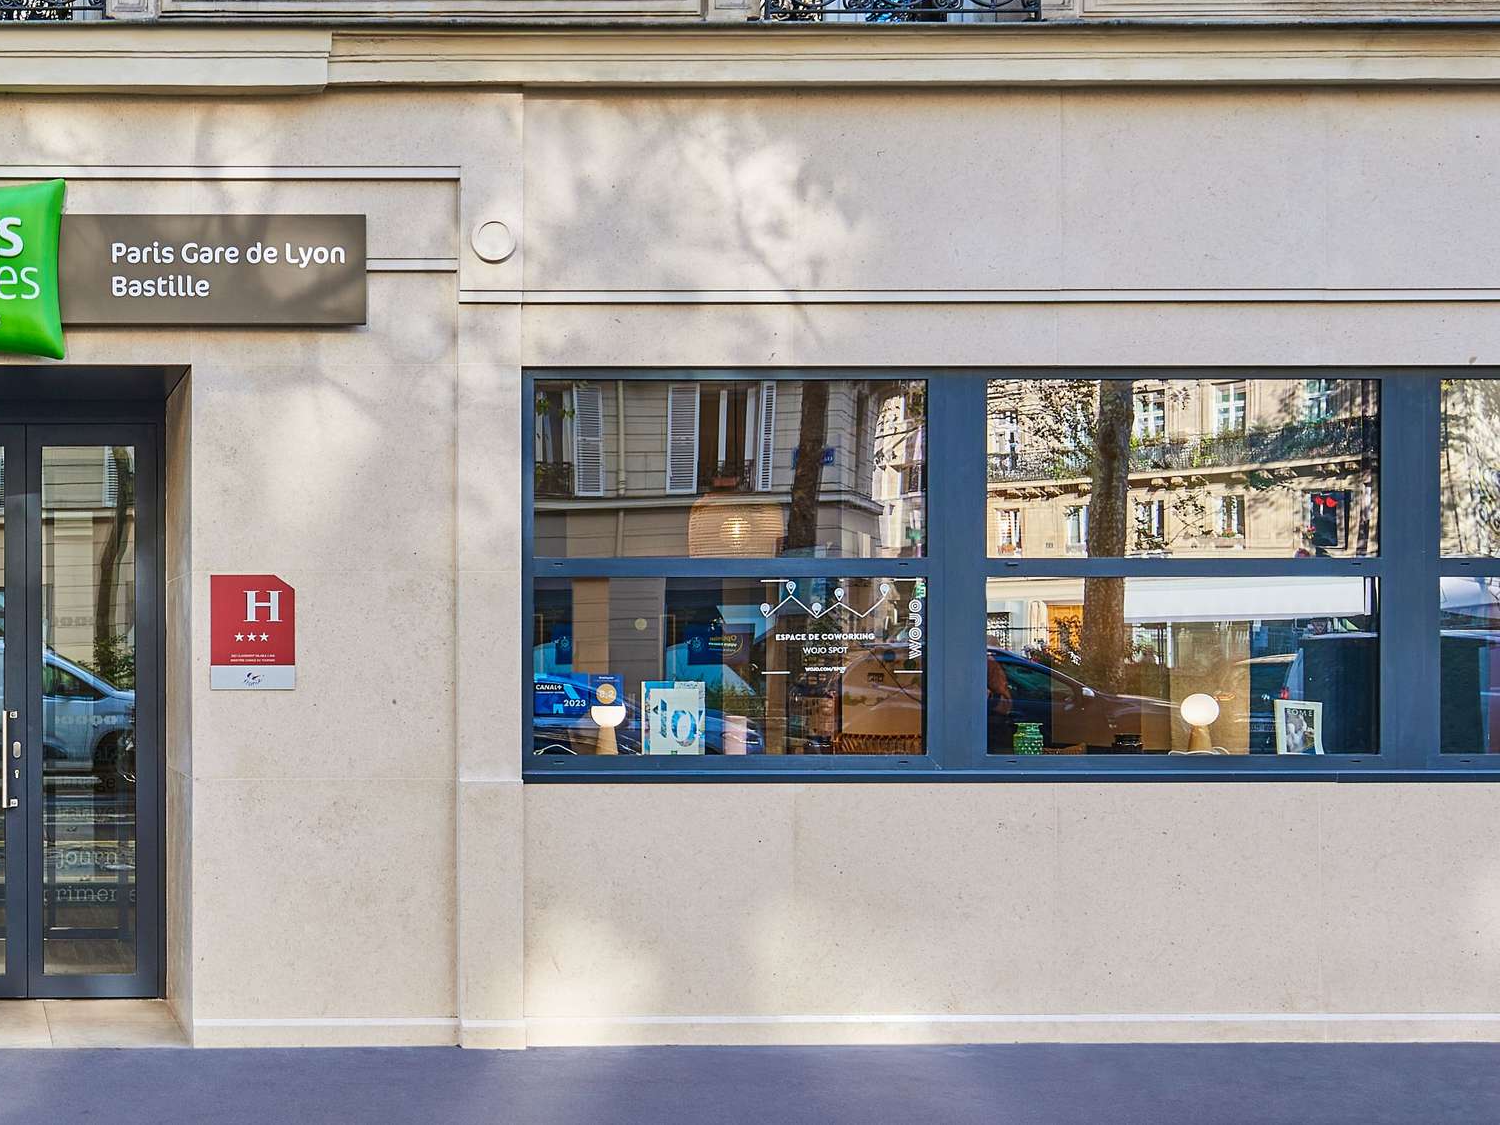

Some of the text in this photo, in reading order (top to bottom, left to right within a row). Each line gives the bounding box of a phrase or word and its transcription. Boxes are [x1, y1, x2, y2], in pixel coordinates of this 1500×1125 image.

[111, 241, 346, 269] Paris Gare de Lyon
[111, 275, 210, 297] Bastille
[243, 590, 283, 623] H
[775, 633, 876, 641] ESPACE DE COWORKING
[908, 599, 923, 660] WOJO
[803, 646, 849, 655] WOJO SPOT
[563, 699, 587, 707] 2023
